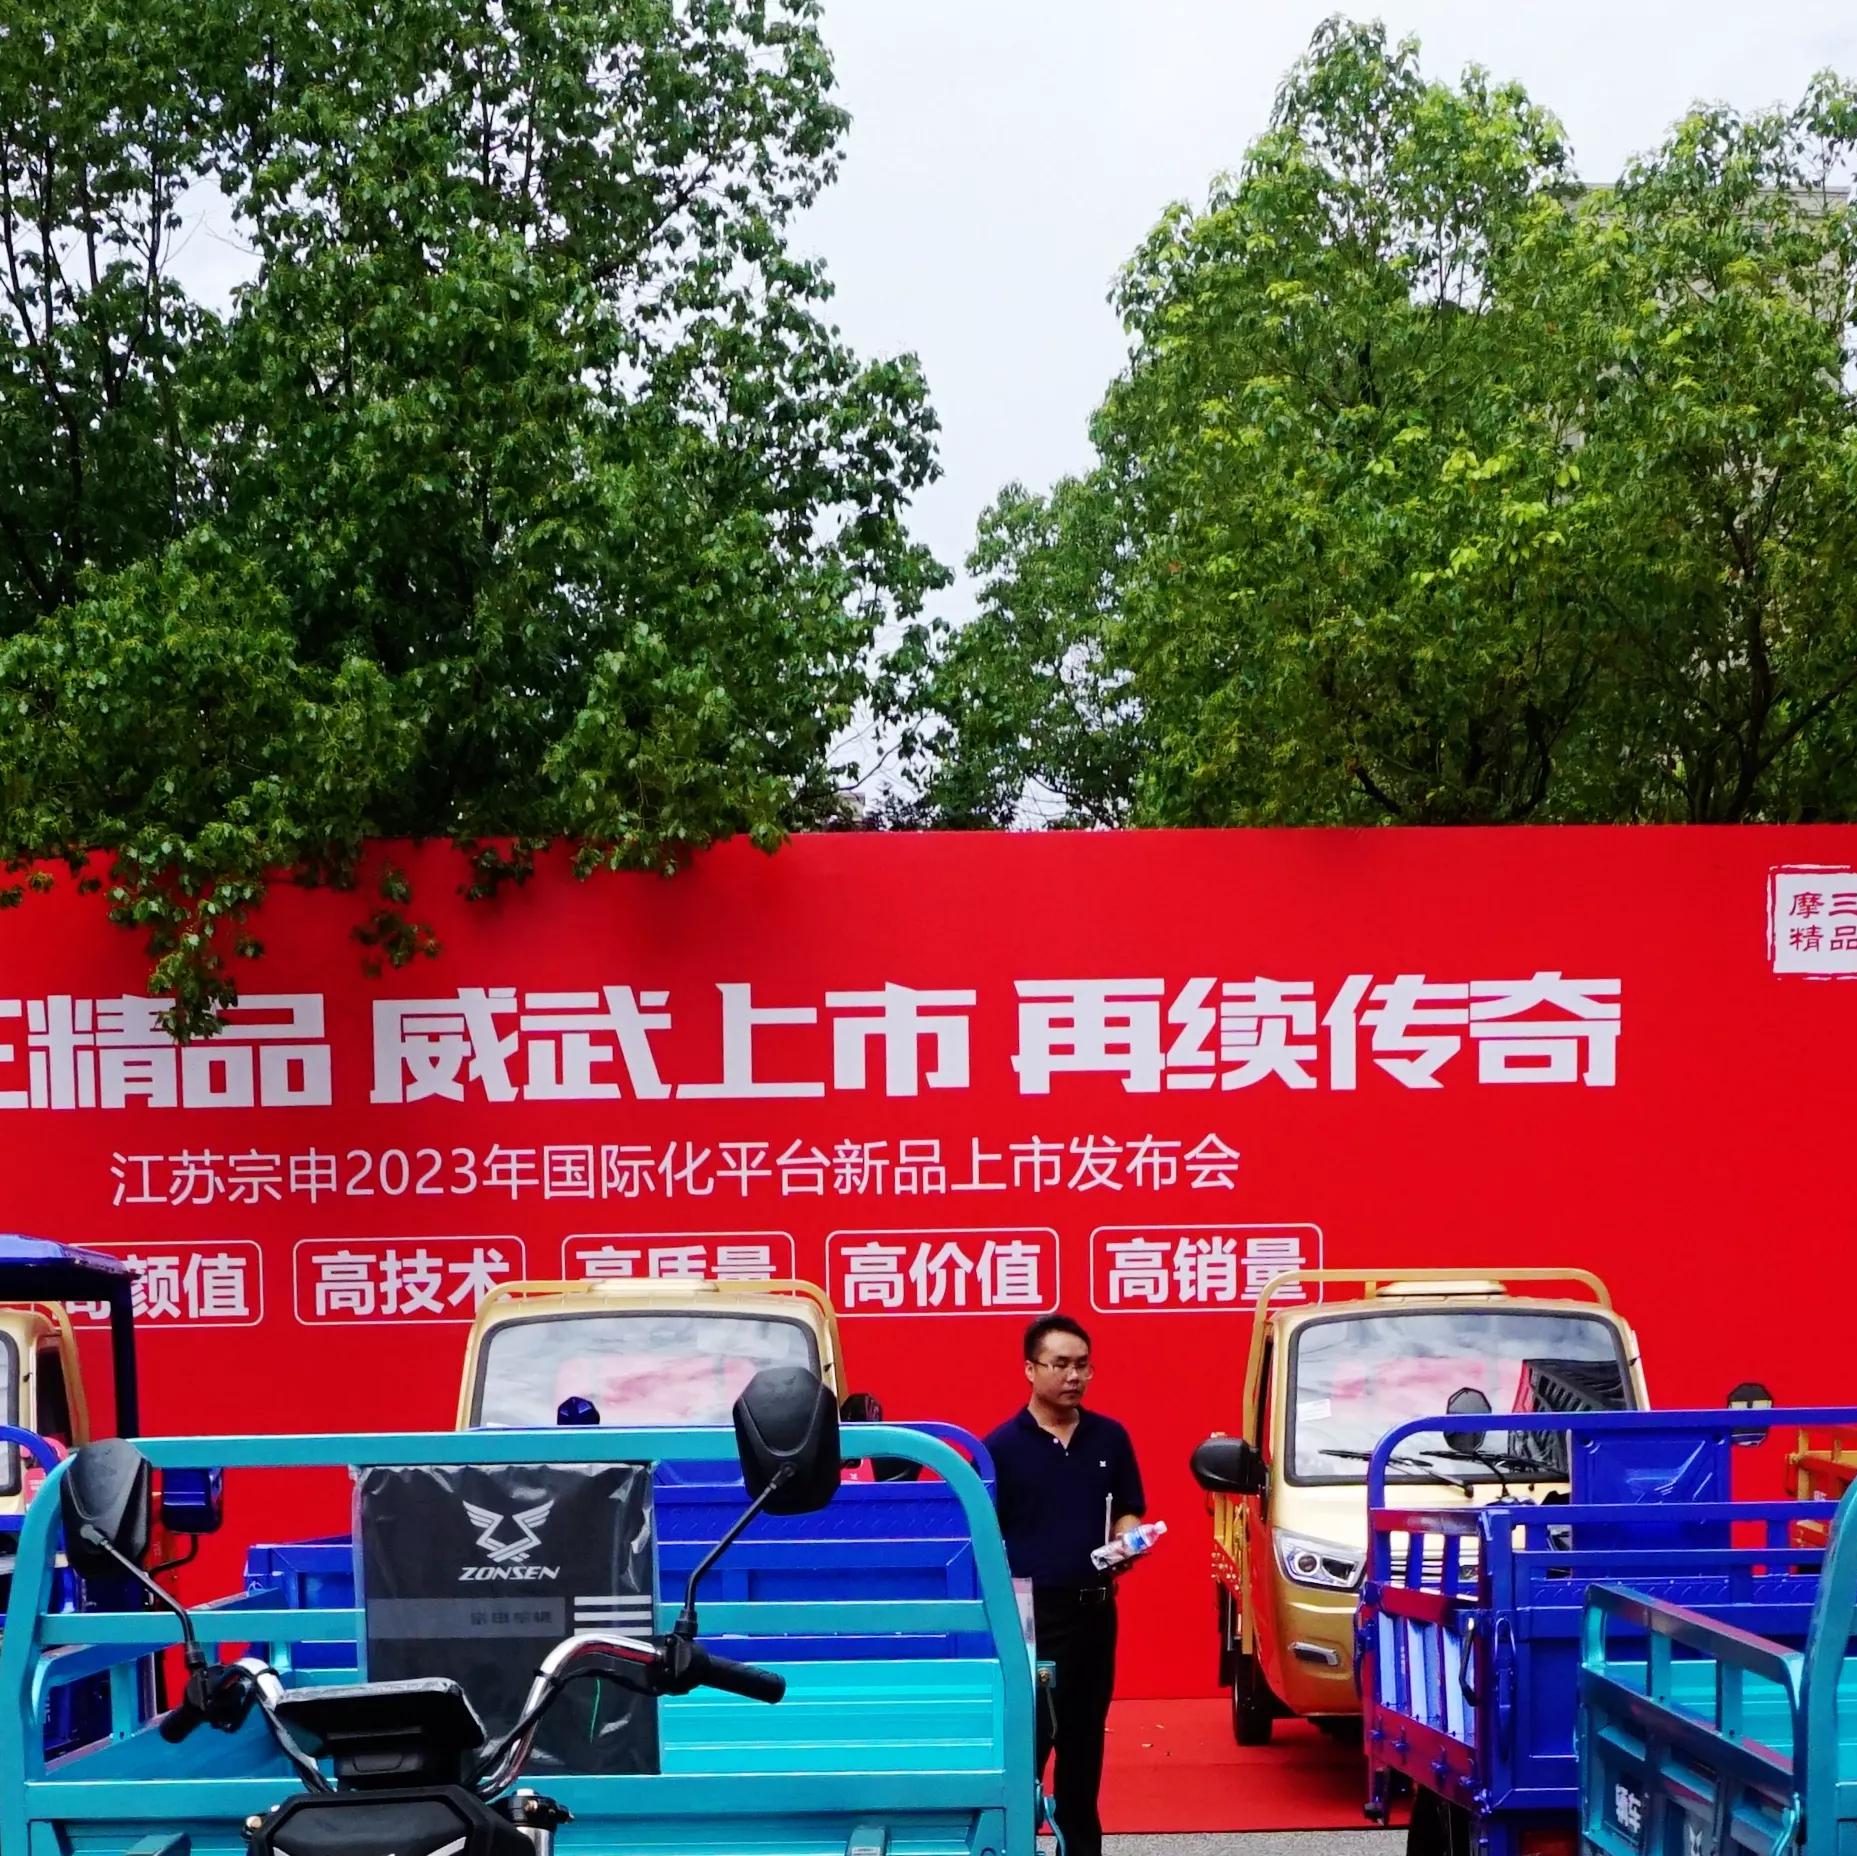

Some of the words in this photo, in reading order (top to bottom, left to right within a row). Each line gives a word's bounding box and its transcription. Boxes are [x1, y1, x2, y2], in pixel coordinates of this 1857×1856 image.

[370, 981, 977, 1104] 威武上市
[1010, 971, 1622, 1095] 再续传奇
[111, 1133, 1241, 1206] 江苏宗申2023年国际化平台新品上市发布会
[311, 1248, 516, 1316] 高技术
[841, 1240, 1042, 1309] 高价值
[1106, 1236, 1307, 1305] 高销量
[458, 1565, 561, 1581] ZONSEN
